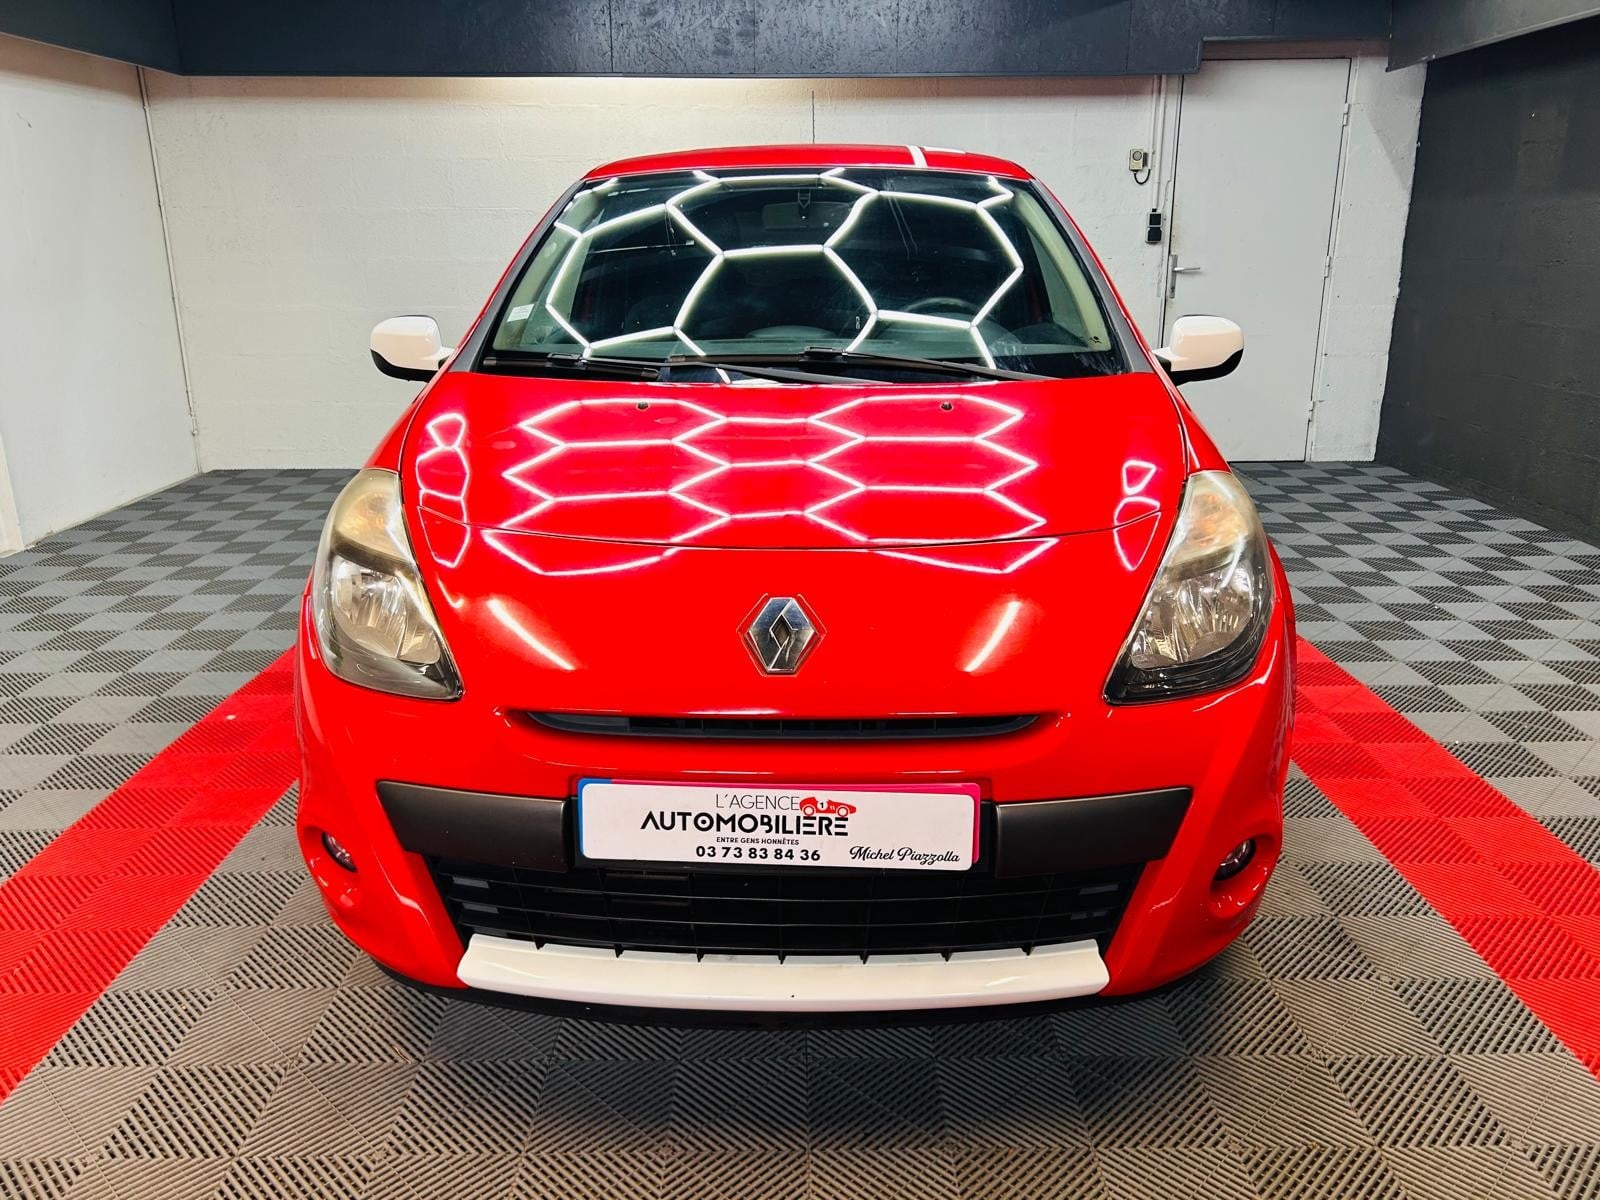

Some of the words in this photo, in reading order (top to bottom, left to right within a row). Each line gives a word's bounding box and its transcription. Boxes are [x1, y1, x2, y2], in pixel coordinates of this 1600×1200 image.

[715, 793, 800, 811] L'AGENCE
[716, 836, 739, 844] ENTRE
[761, 837, 800, 846] HONNÊTES
[695, 845, 717, 858] 03
[721, 846, 743, 859] 73
[748, 847, 769, 860] 83
[774, 848, 795, 860] 84
[799, 849, 821, 861] 36
[849, 845, 895, 861] Michel
[897, 847, 960, 866] Piazzolla
